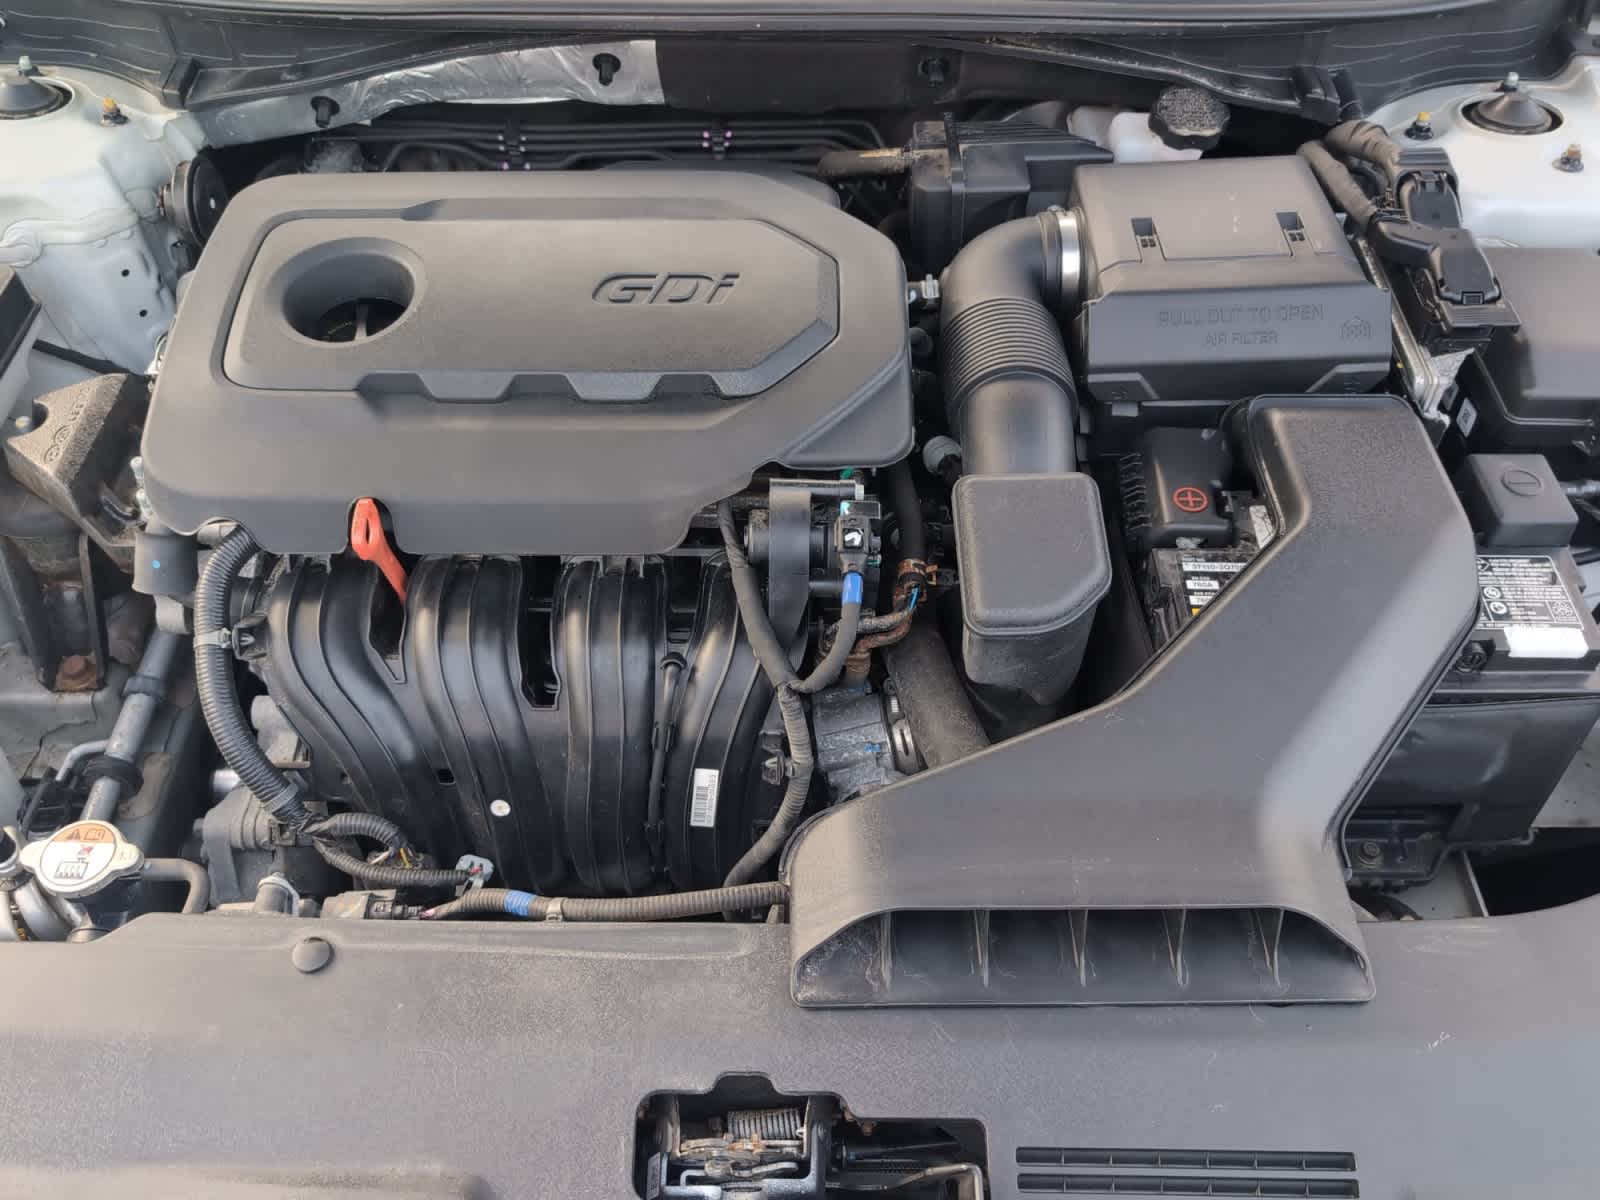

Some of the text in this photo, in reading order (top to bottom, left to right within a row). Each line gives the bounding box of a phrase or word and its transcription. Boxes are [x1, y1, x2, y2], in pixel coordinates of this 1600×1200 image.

[591, 271, 741, 304] GDi
[1159, 303, 1325, 327] PULL OUT TO OPEN
[1204, 331, 1279, 346] AIR FILTER
